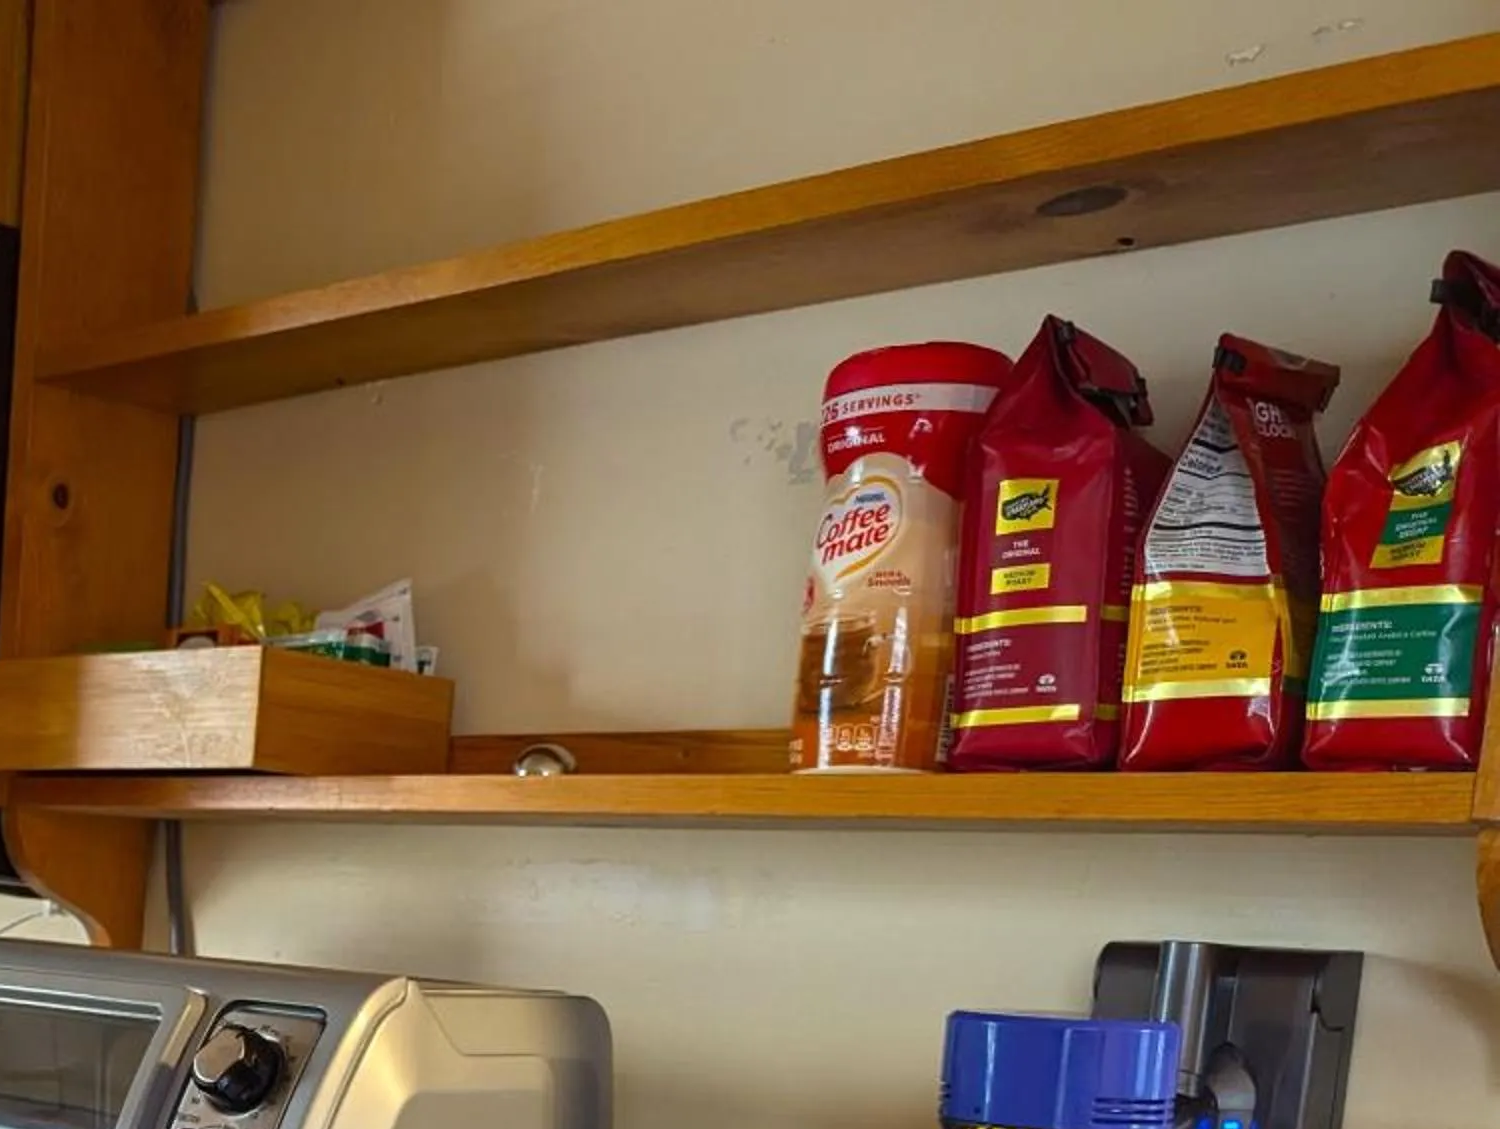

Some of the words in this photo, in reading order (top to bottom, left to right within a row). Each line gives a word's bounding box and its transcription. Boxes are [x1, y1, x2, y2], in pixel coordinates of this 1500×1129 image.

[816, 503, 891, 549] Coffee
[821, 523, 890, 565] mate
[1012, 539, 1029, 549] THE
